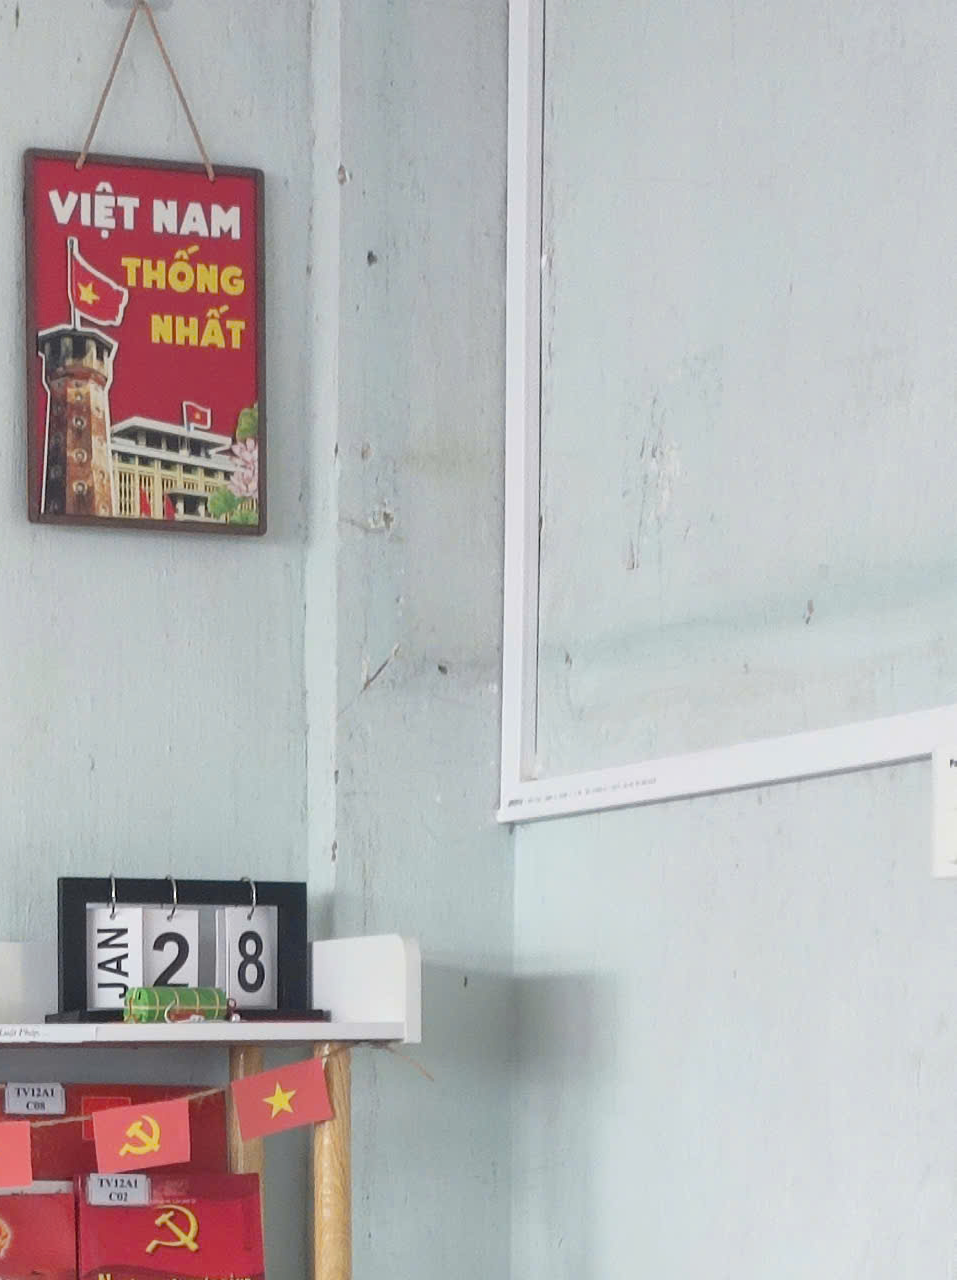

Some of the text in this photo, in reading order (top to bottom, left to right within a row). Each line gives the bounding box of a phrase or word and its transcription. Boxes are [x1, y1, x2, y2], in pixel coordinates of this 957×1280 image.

[48, 181, 241, 240] VIỆT NAM
[120, 244, 246, 296] THỐNG
[150, 304, 246, 350] NHẤT
[97, 928, 130, 999] JAN
[152, 931, 190, 988] 2
[237, 930, 265, 993] 8
[14, 1087, 55, 1098] TV12A1
[98, 1178, 138, 1189] TV12A1
[109, 1191, 128, 1202] C02
